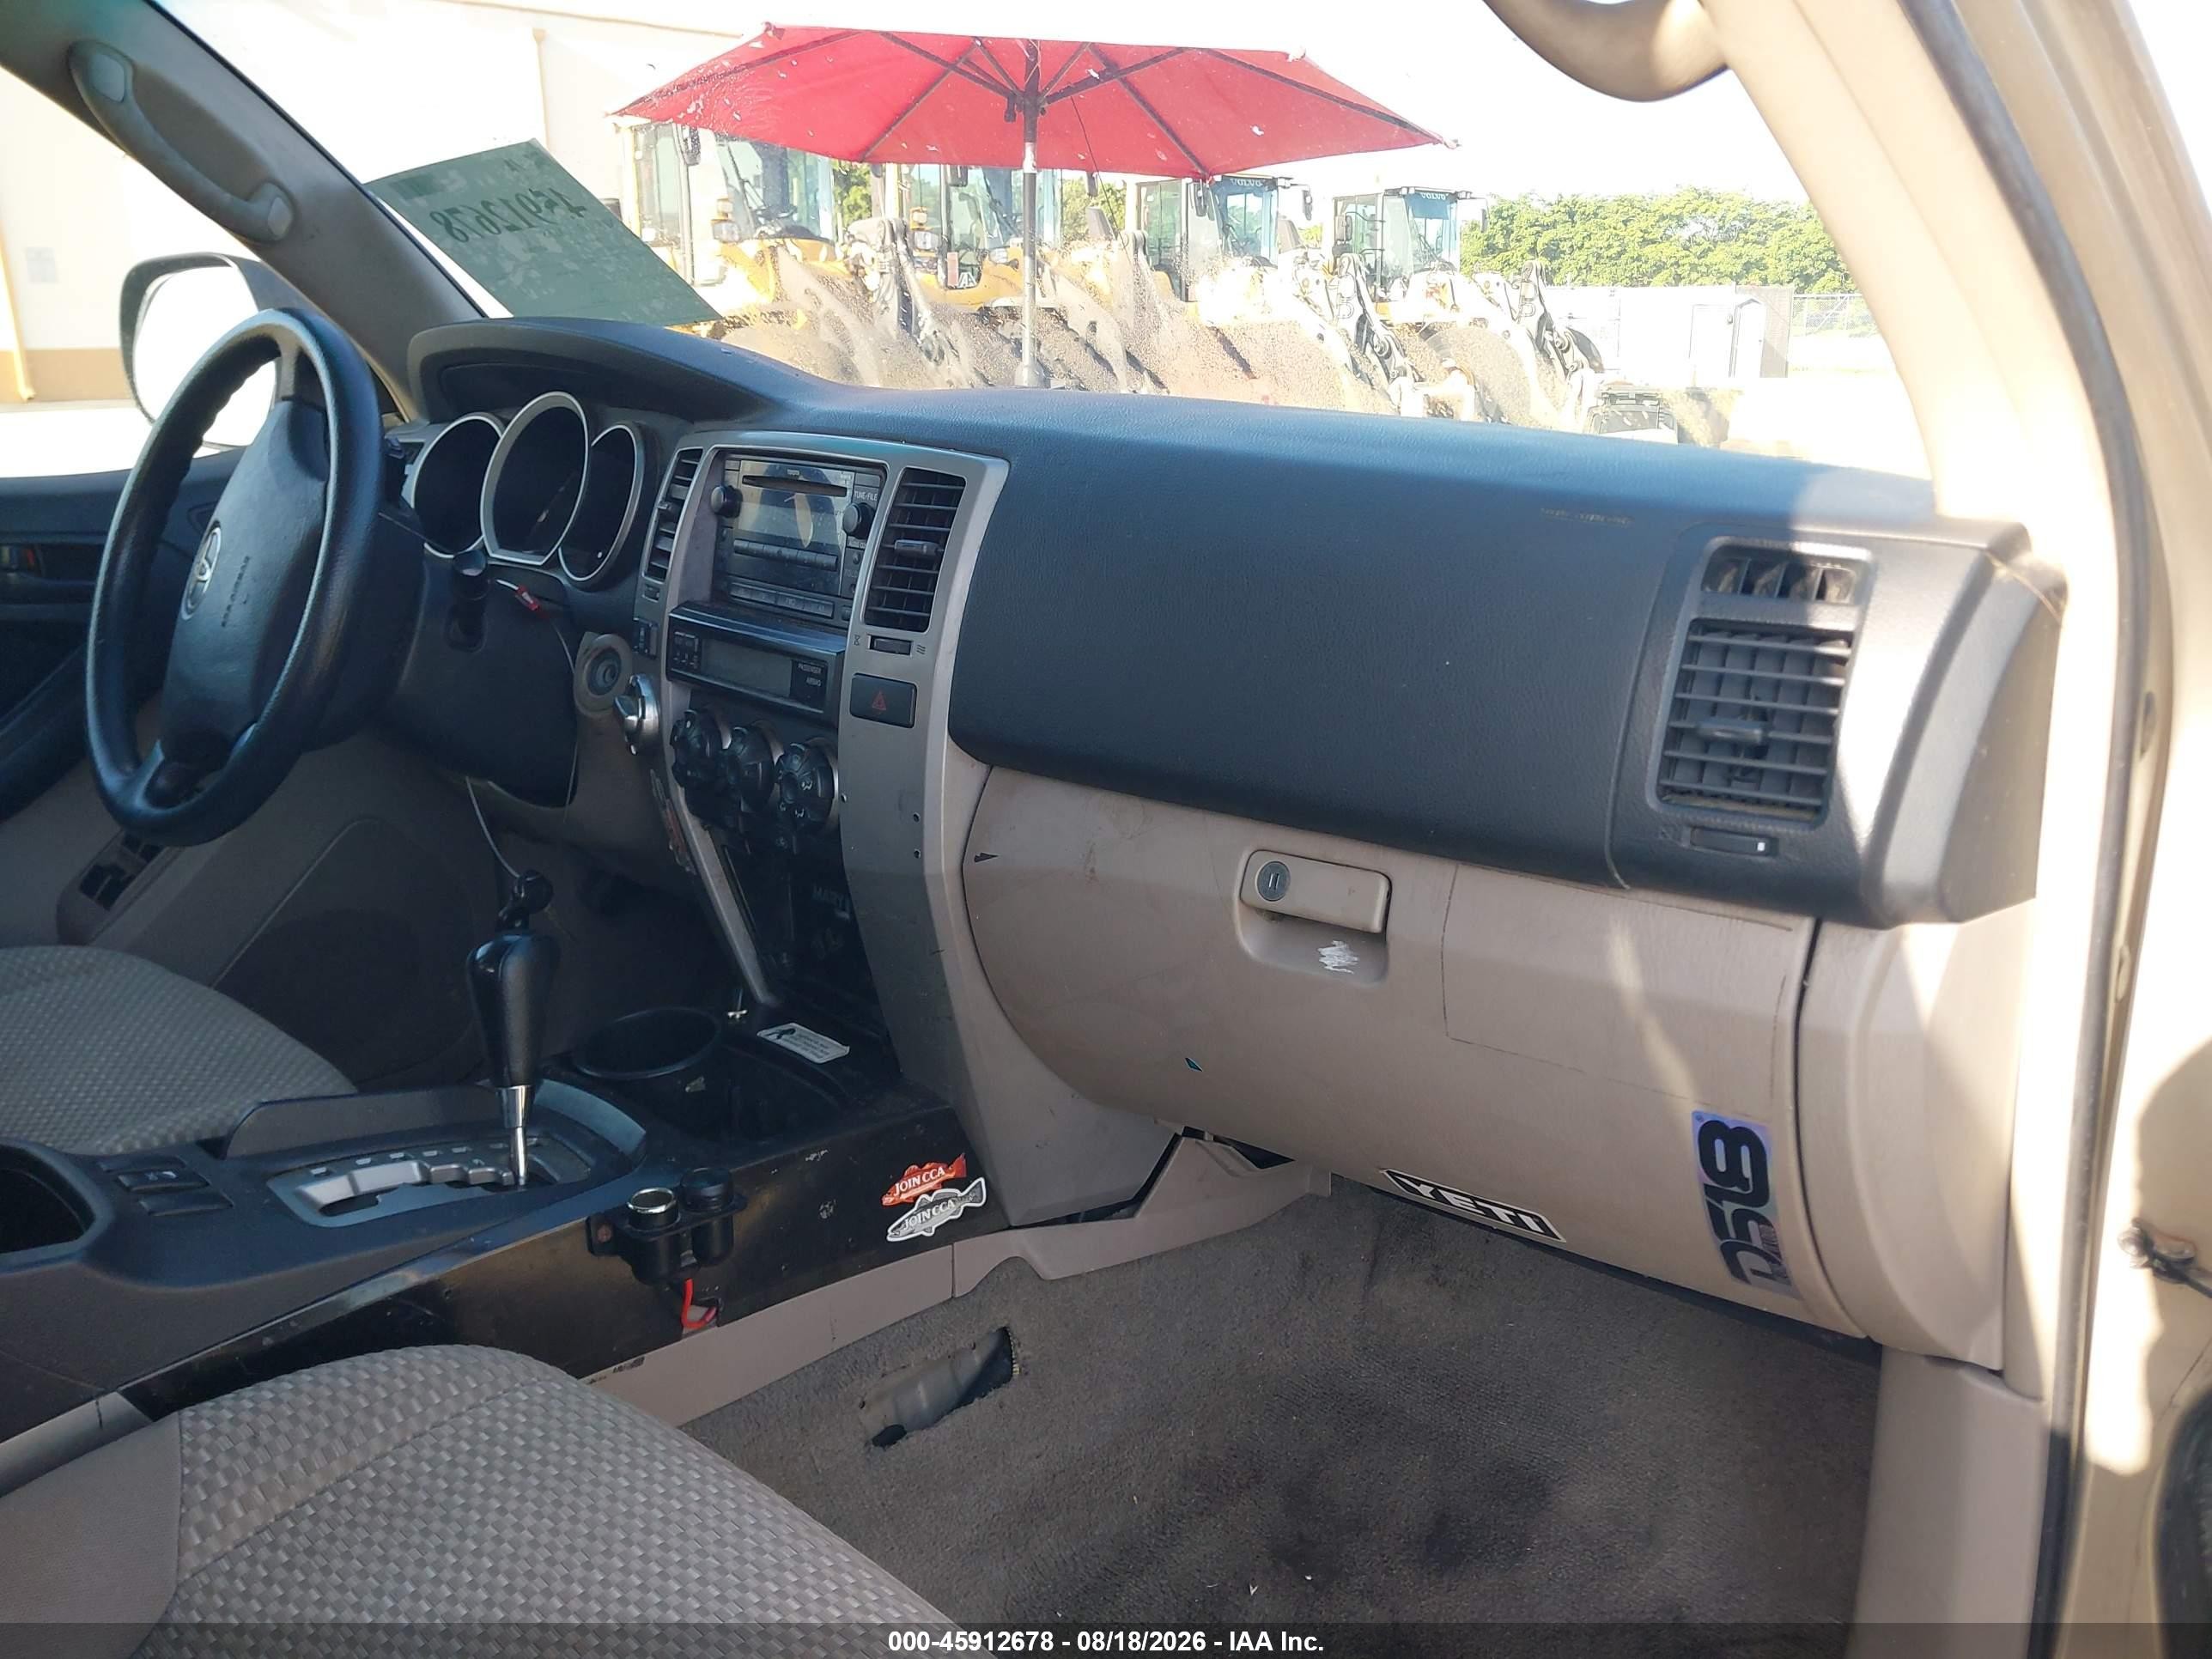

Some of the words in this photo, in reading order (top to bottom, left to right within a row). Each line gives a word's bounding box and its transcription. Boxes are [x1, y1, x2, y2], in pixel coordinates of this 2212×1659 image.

[1230, 178, 1263, 186] VOLVO
[1420, 191, 1446, 200] VOLVO
[894, 1174, 921, 1195] JOIN
[922, 1166, 945, 1182] CCA
[904, 1210, 931, 1229] JOIN
[933, 1200, 955, 1216] CCA
[1393, 1175, 1547, 1234] YETI
